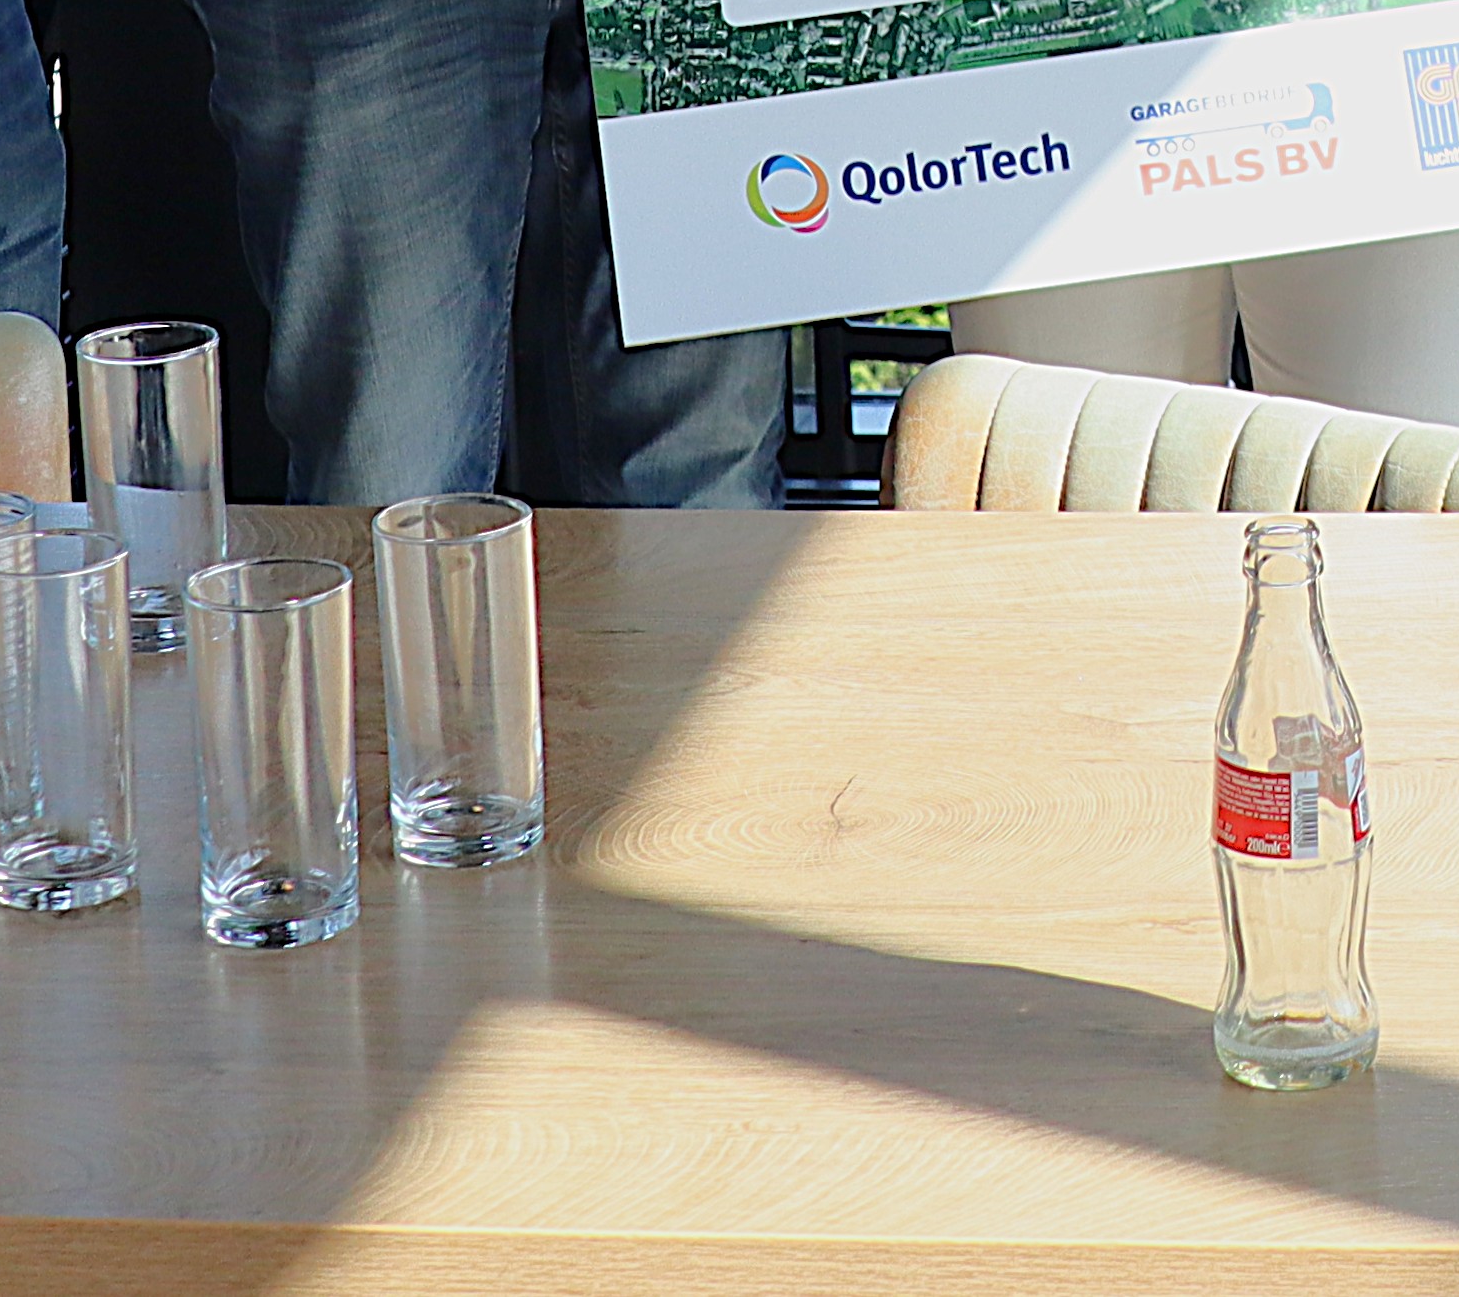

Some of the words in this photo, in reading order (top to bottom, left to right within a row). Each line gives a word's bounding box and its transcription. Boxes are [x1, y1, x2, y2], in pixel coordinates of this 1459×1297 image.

[842, 132, 1072, 206] QolorTech
[1139, 148, 1265, 196] PALS
[1276, 136, 1339, 177] BV
